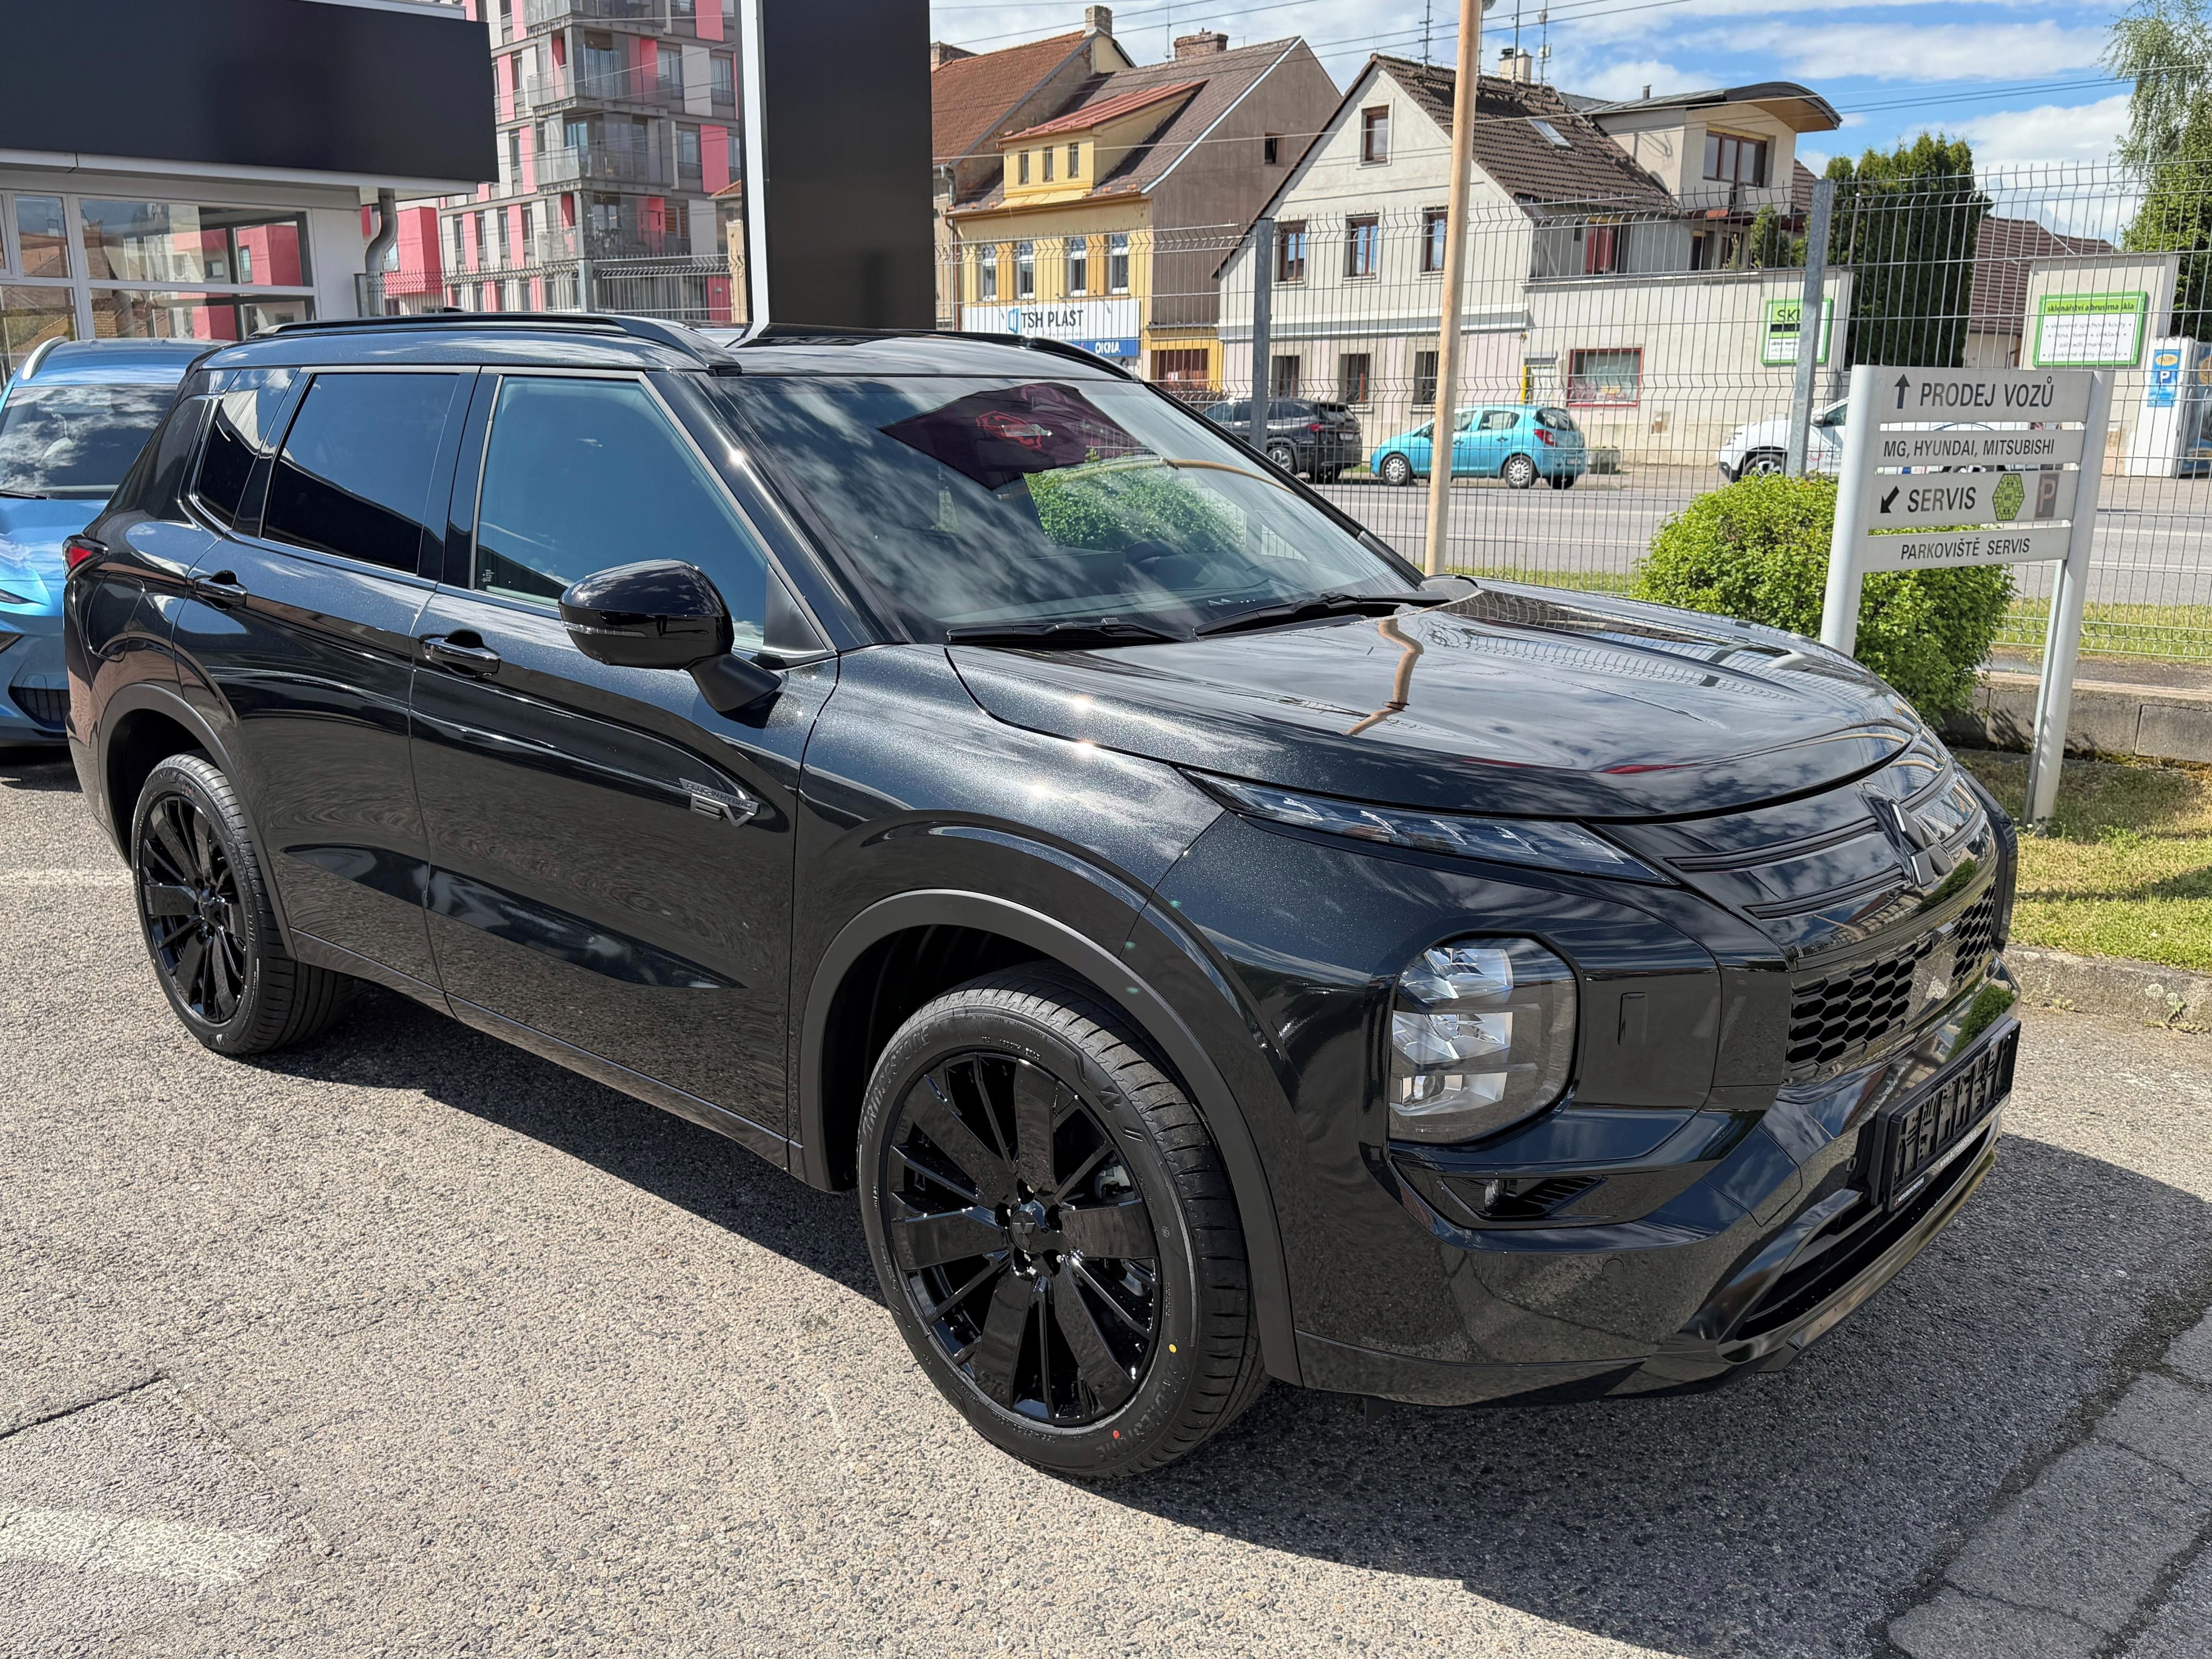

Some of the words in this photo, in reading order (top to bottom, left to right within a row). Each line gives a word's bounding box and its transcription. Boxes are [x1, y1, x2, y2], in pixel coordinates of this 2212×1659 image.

[1021, 312, 1043, 328] TSH
[1048, 309, 1084, 327] PLAST
[2160, 370, 2170, 384] P
[1919, 383, 1995, 407] PRODEJ
[2005, 376, 2054, 407] VOZŮ
[1883, 440, 1910, 458] MG,
[1913, 440, 1977, 457] HYUNDAI,
[1983, 439, 2054, 455] MITSUBISHI
[1907, 486, 1977, 512] SERVIS
[1901, 537, 1980, 560] PARKOVIŠTĚ
[1987, 538, 2031, 555] SERVIS
[687, 784, 720, 800] PLUG-IN
[720, 793, 752, 808] HYBRID
